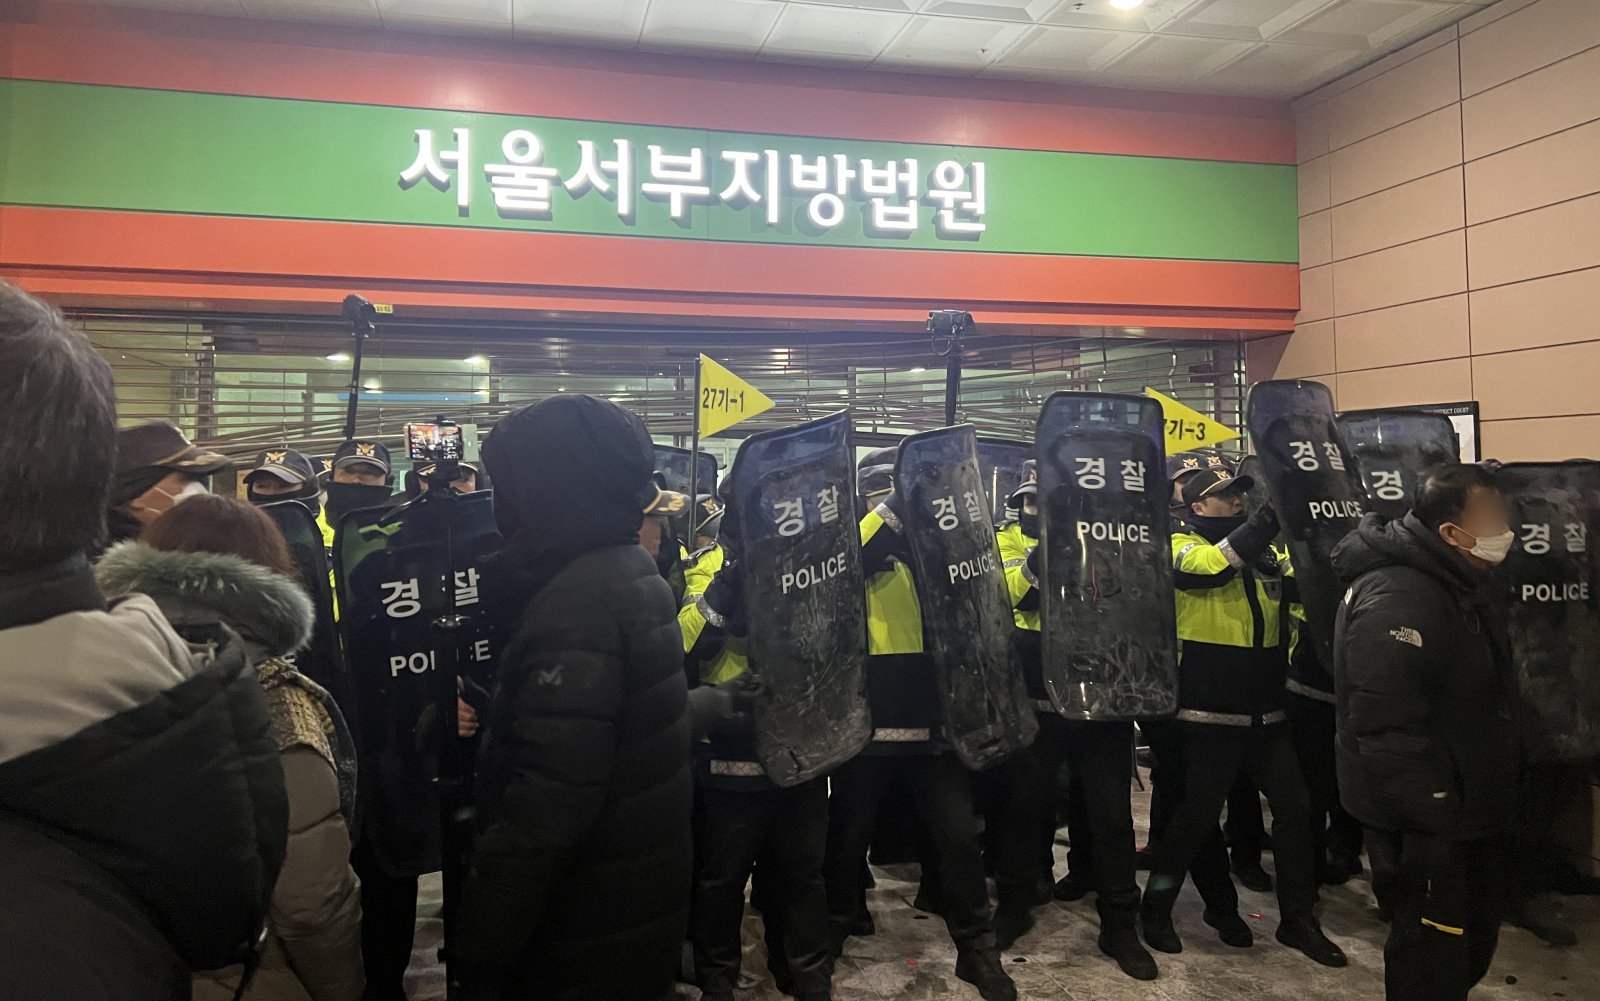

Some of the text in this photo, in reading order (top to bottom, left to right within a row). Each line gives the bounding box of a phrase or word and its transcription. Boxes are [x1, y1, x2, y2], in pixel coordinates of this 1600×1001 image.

[399, 127, 987, 234] 서울서부지방법원
[702, 387, 744, 413] 27기-1
[1308, 500, 1364, 519] POLICE
[1076, 521, 1150, 543] POLICE
[781, 552, 847, 594] POLICE
[948, 552, 996, 584] POLICE
[1522, 582, 1590, 602] POLICE
